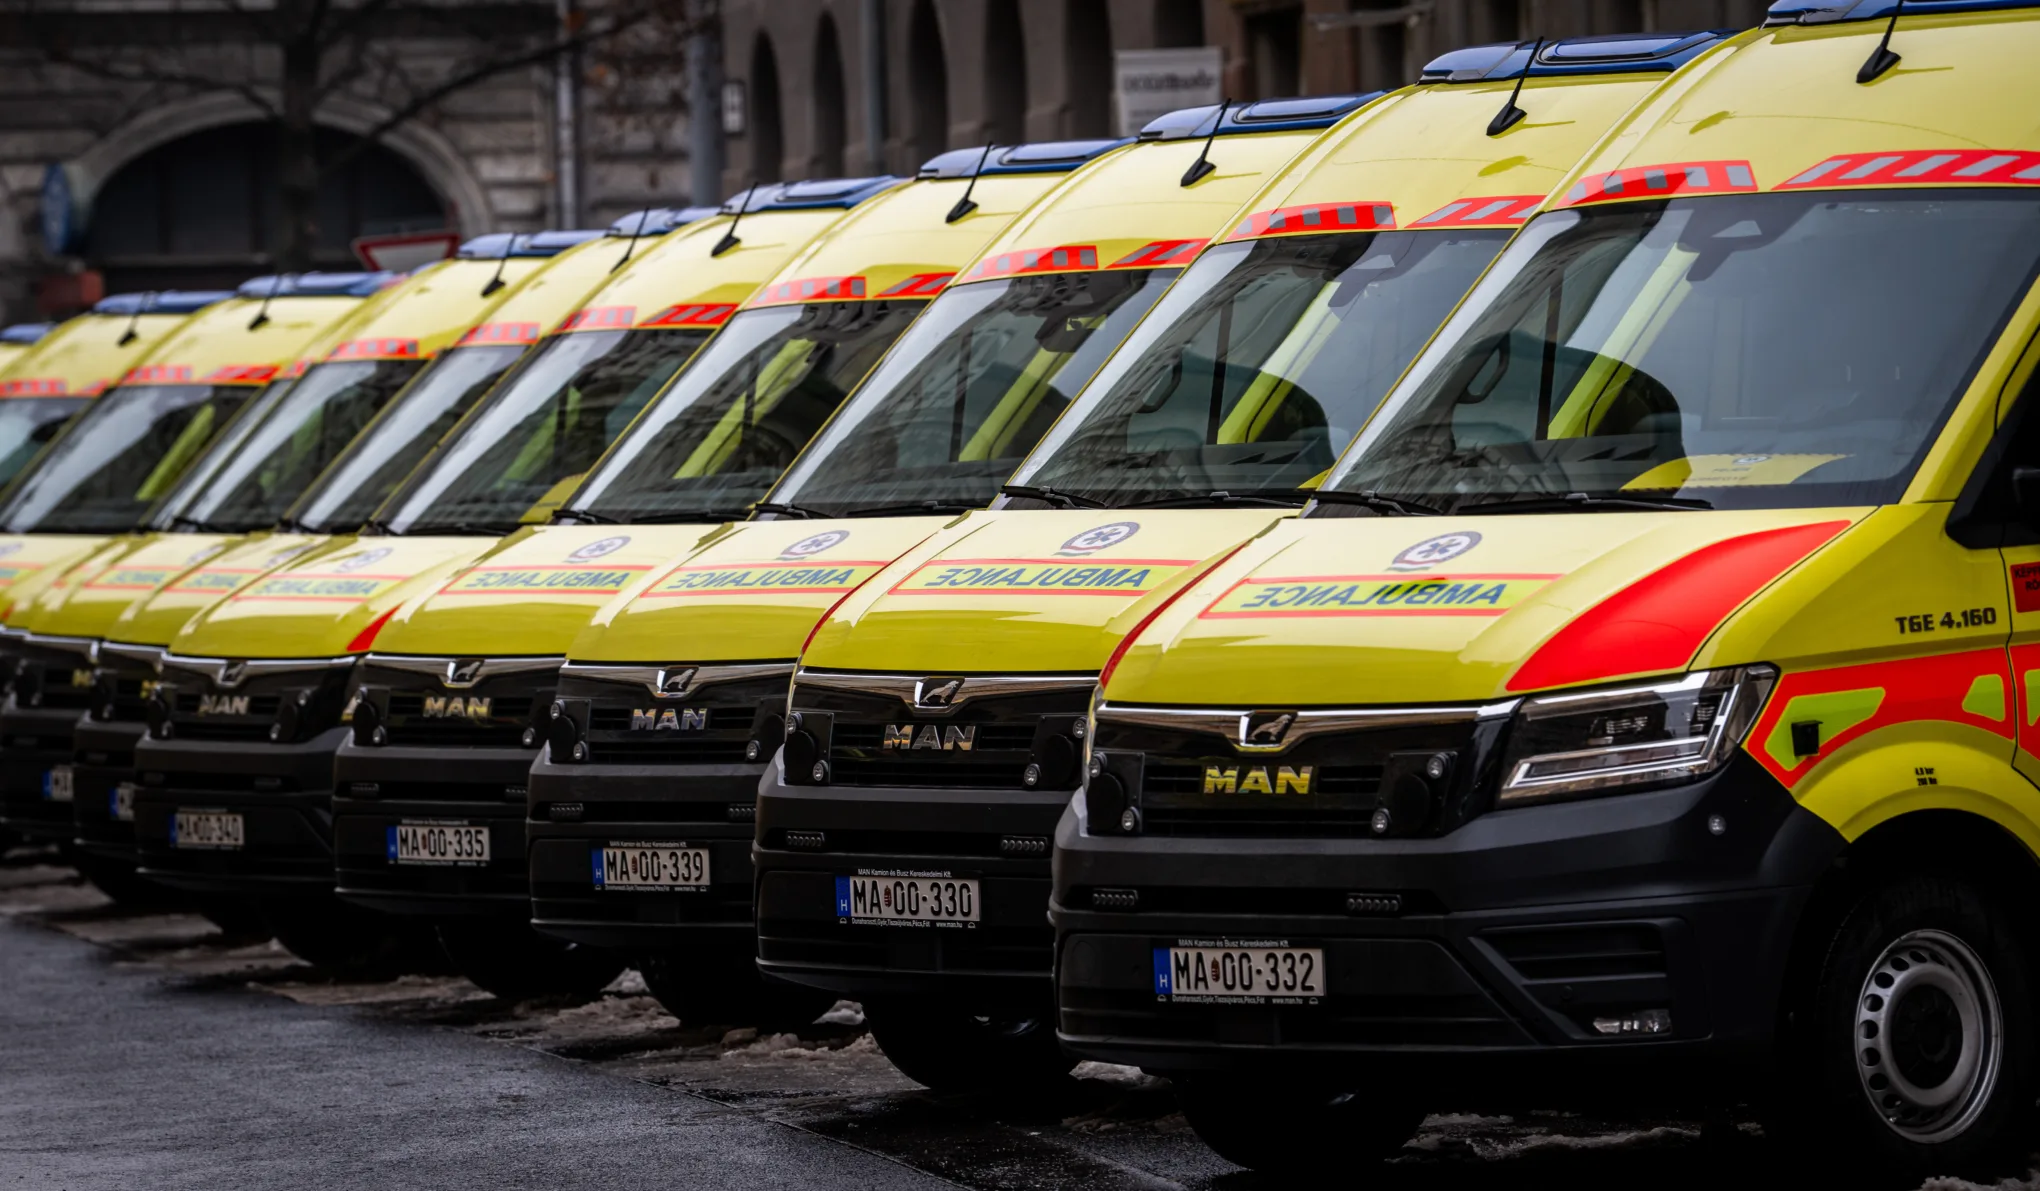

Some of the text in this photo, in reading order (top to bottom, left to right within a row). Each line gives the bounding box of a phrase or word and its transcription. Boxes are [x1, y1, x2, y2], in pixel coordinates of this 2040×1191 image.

[1895, 607, 1997, 634] TGE 4.160
[422, 696, 493, 719] MAN
[630, 708, 708, 731] MAN
[882, 724, 977, 750] MAN
[1203, 765, 1314, 794] MAN
[606, 851, 630, 881] MA
[840, 899, 848, 911] H
[853, 879, 882, 914] MA
[1159, 974, 1168, 988] H
[1174, 952, 1209, 990] MA
